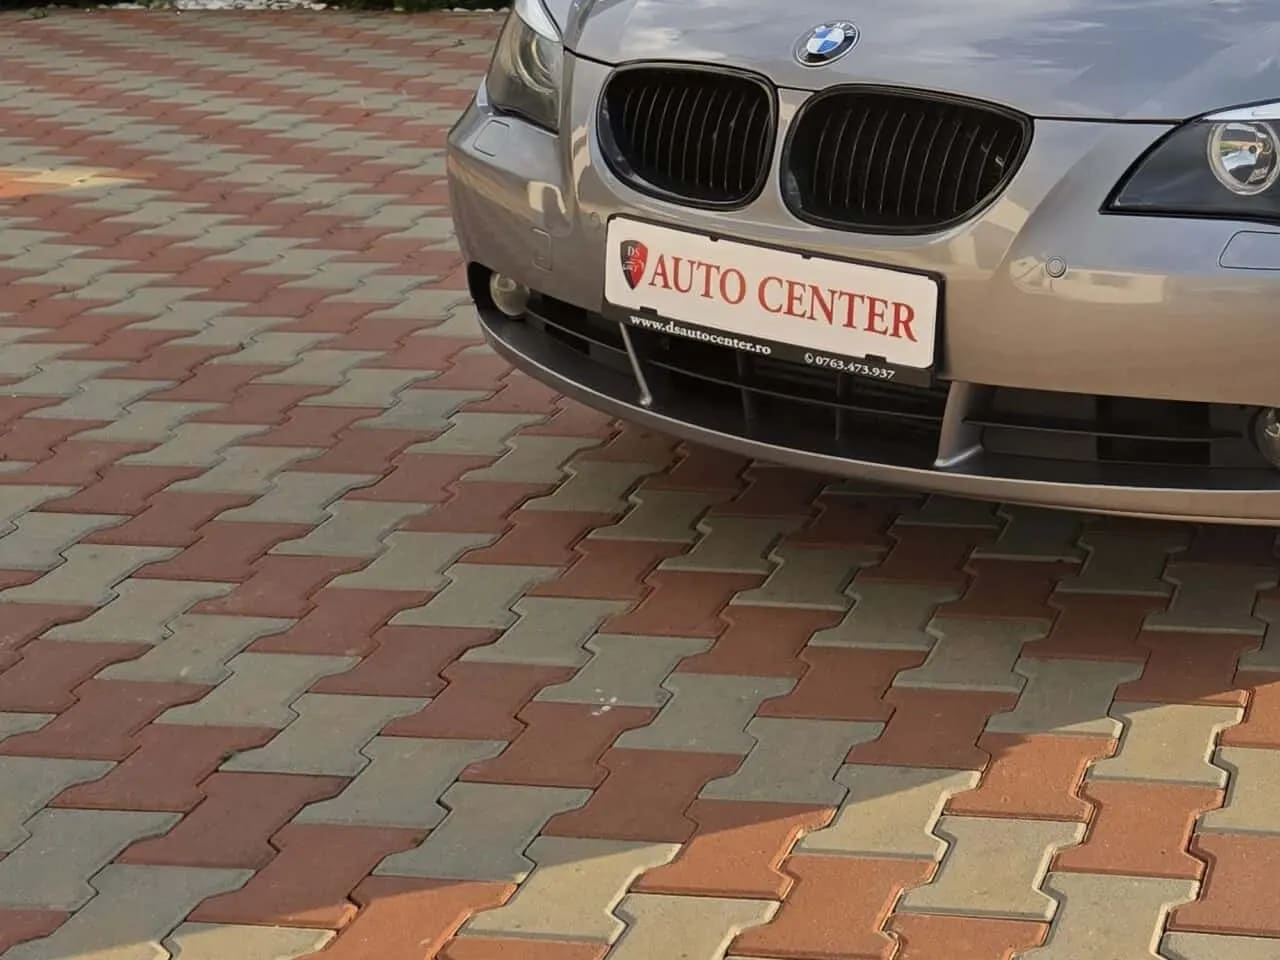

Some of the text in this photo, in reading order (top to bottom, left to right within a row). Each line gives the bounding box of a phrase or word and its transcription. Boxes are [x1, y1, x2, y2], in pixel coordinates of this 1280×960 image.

[648, 253, 746, 305] AUTO
[757, 276, 919, 343] CENTER
[630, 314, 772, 356] www.dsautocenter.ro
